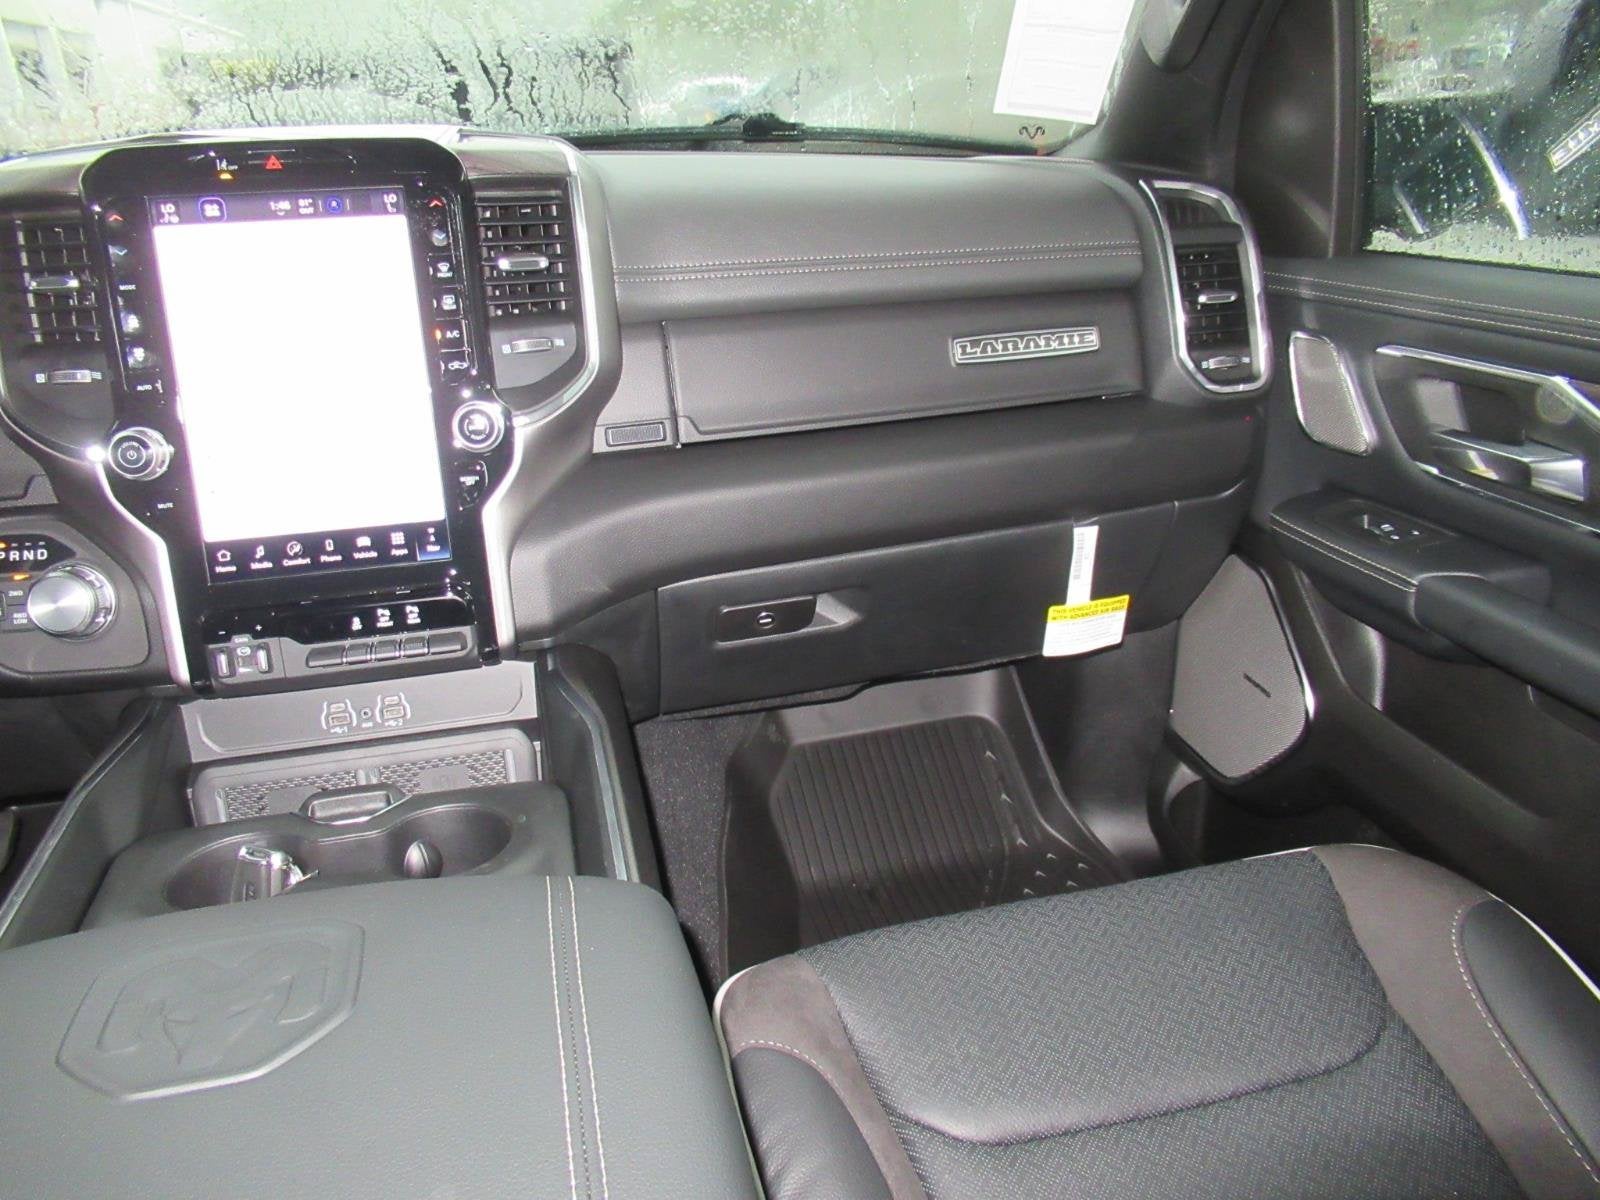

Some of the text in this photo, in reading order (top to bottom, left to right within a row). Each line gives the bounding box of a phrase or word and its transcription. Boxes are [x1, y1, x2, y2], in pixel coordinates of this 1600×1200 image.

[160, 203, 175, 213] LO
[446, 330, 460, 338] A/C
[956, 328, 1098, 361] LARAMIE
[9, 550, 20, 562] R
[23, 549, 34, 560] N
[37, 549, 48, 560] D
[353, 550, 378, 559] Vehicle
[391, 548, 408, 557] Apps
[283, 557, 311, 567] Comfort
[320, 554, 343, 562] Phone
[214, 565, 237, 573] Home
